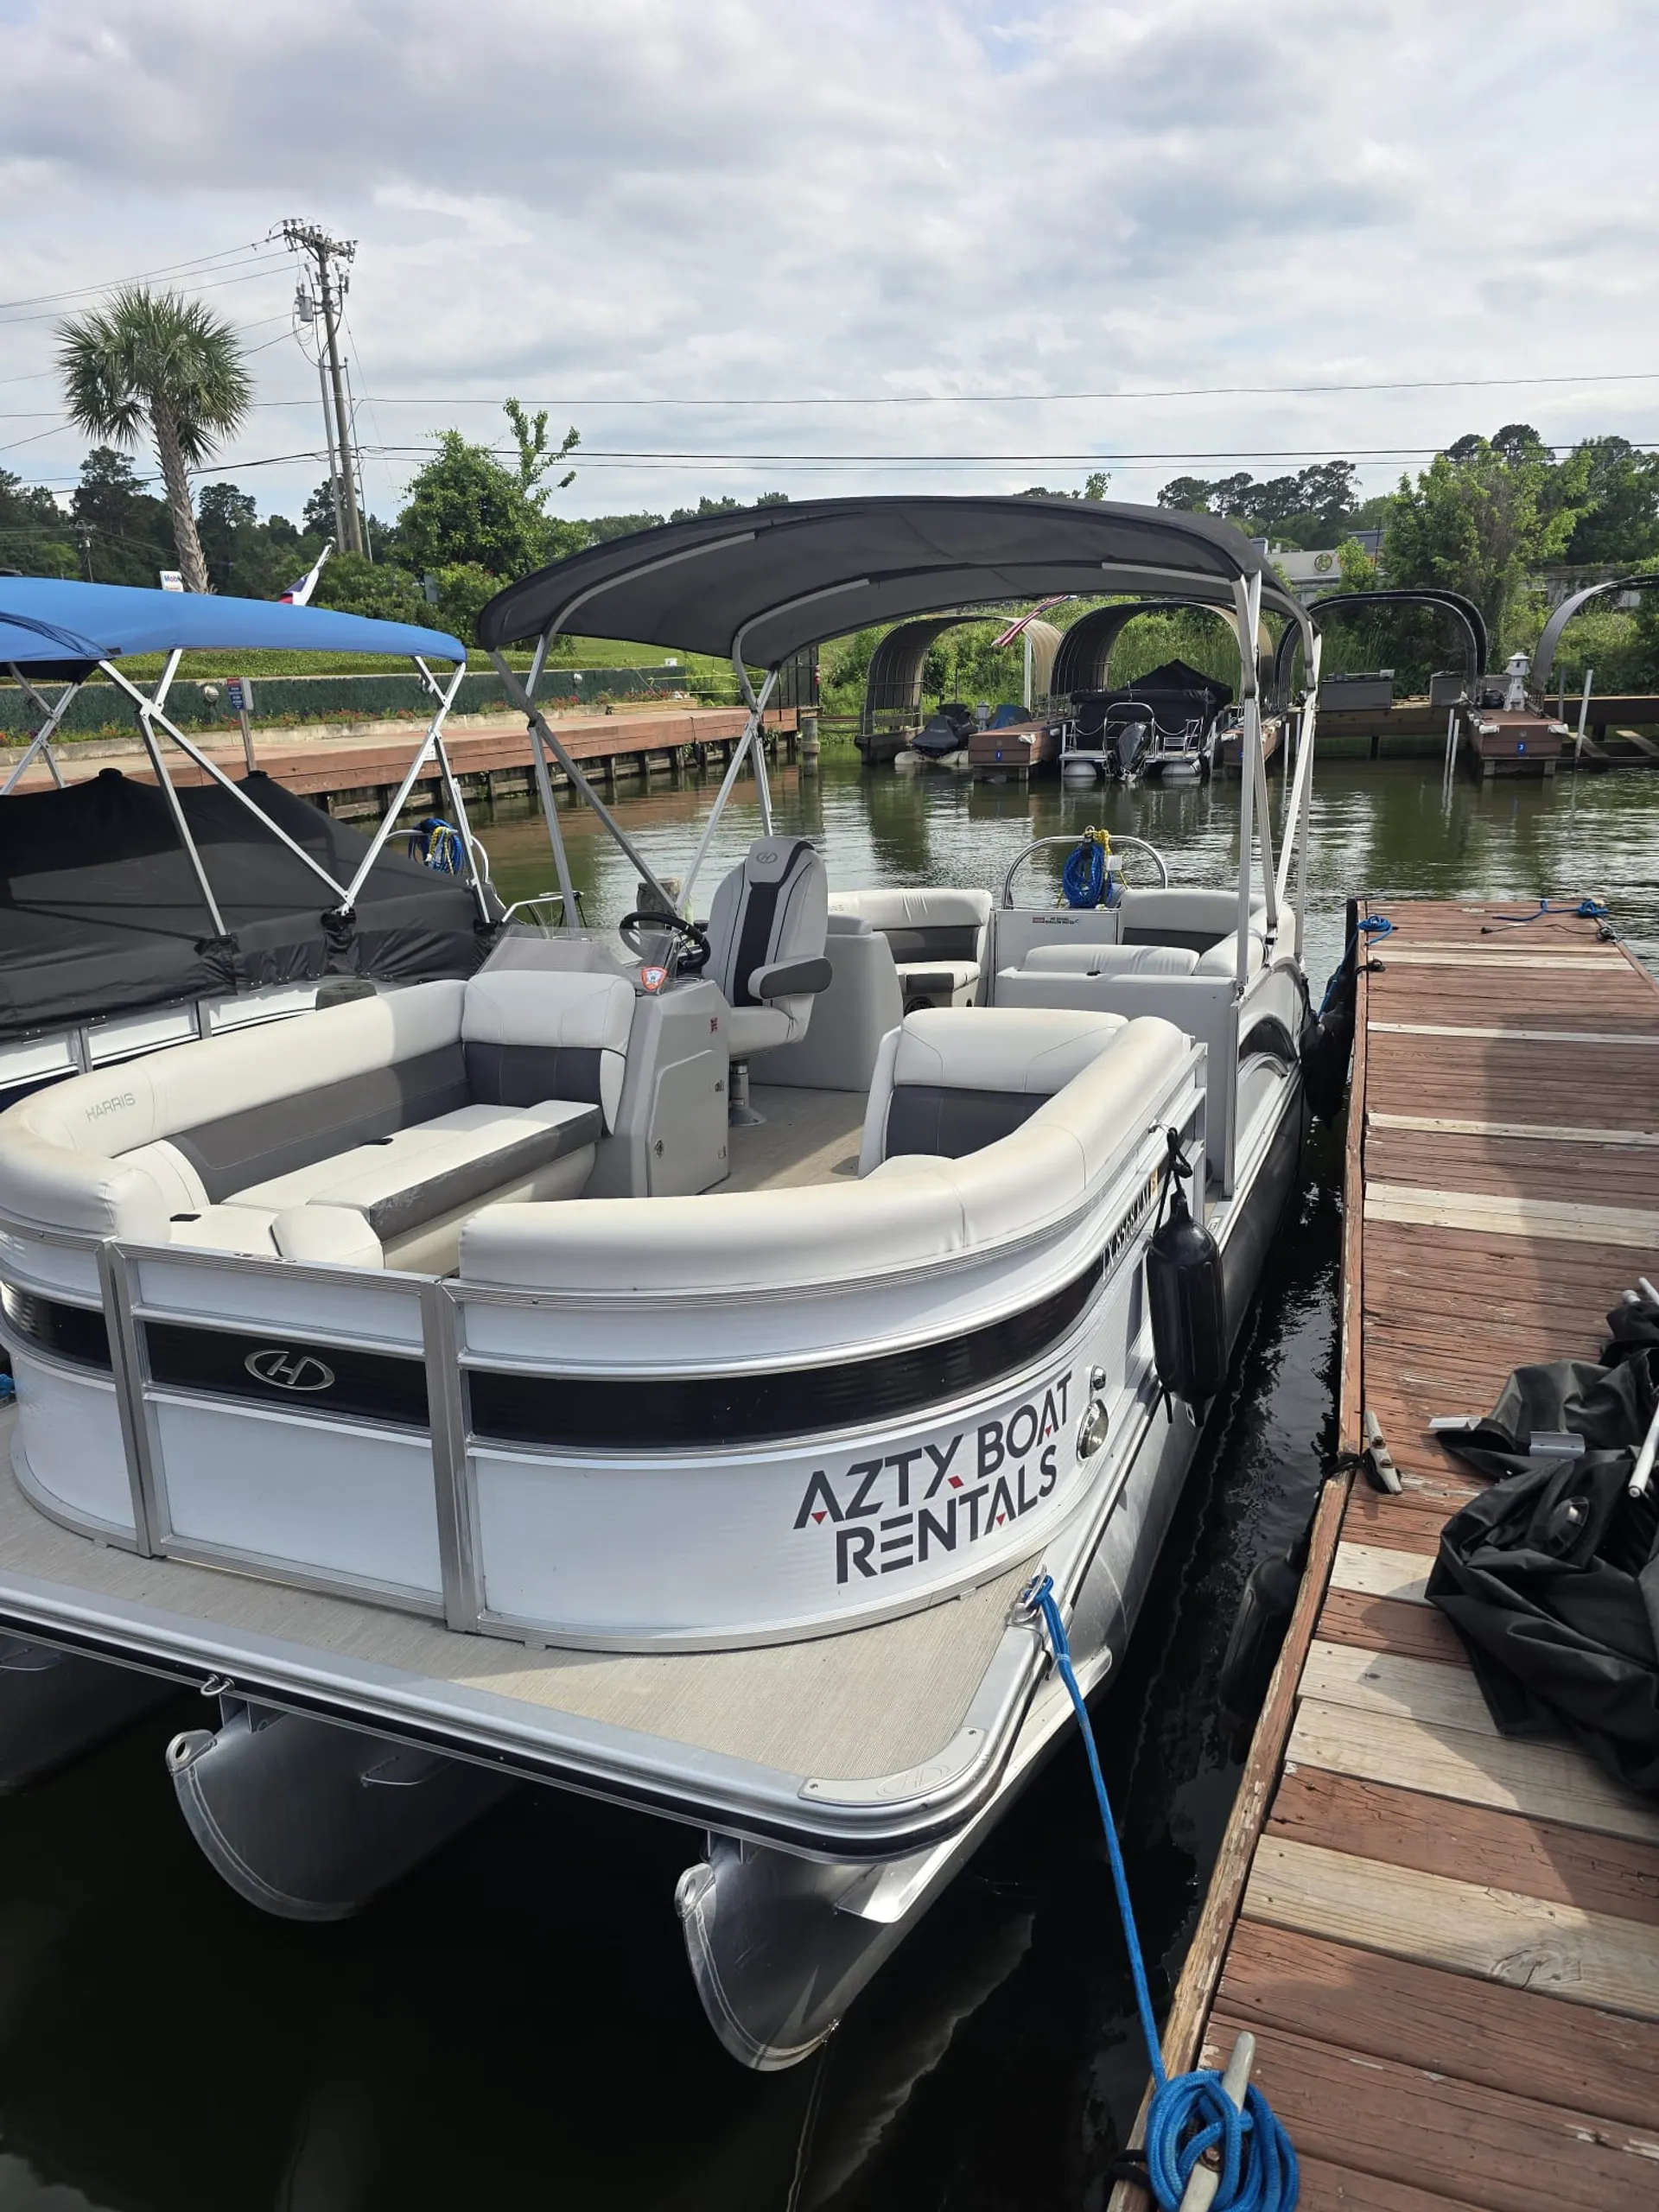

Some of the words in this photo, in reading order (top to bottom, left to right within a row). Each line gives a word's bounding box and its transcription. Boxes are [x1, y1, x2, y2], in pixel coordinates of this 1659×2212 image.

[86, 1092, 136, 1122] HARRIS
[793, 1433, 964, 1529] AZTY
[977, 1370, 1071, 1479] BOAT
[836, 1445, 1057, 1585] RENTALS
